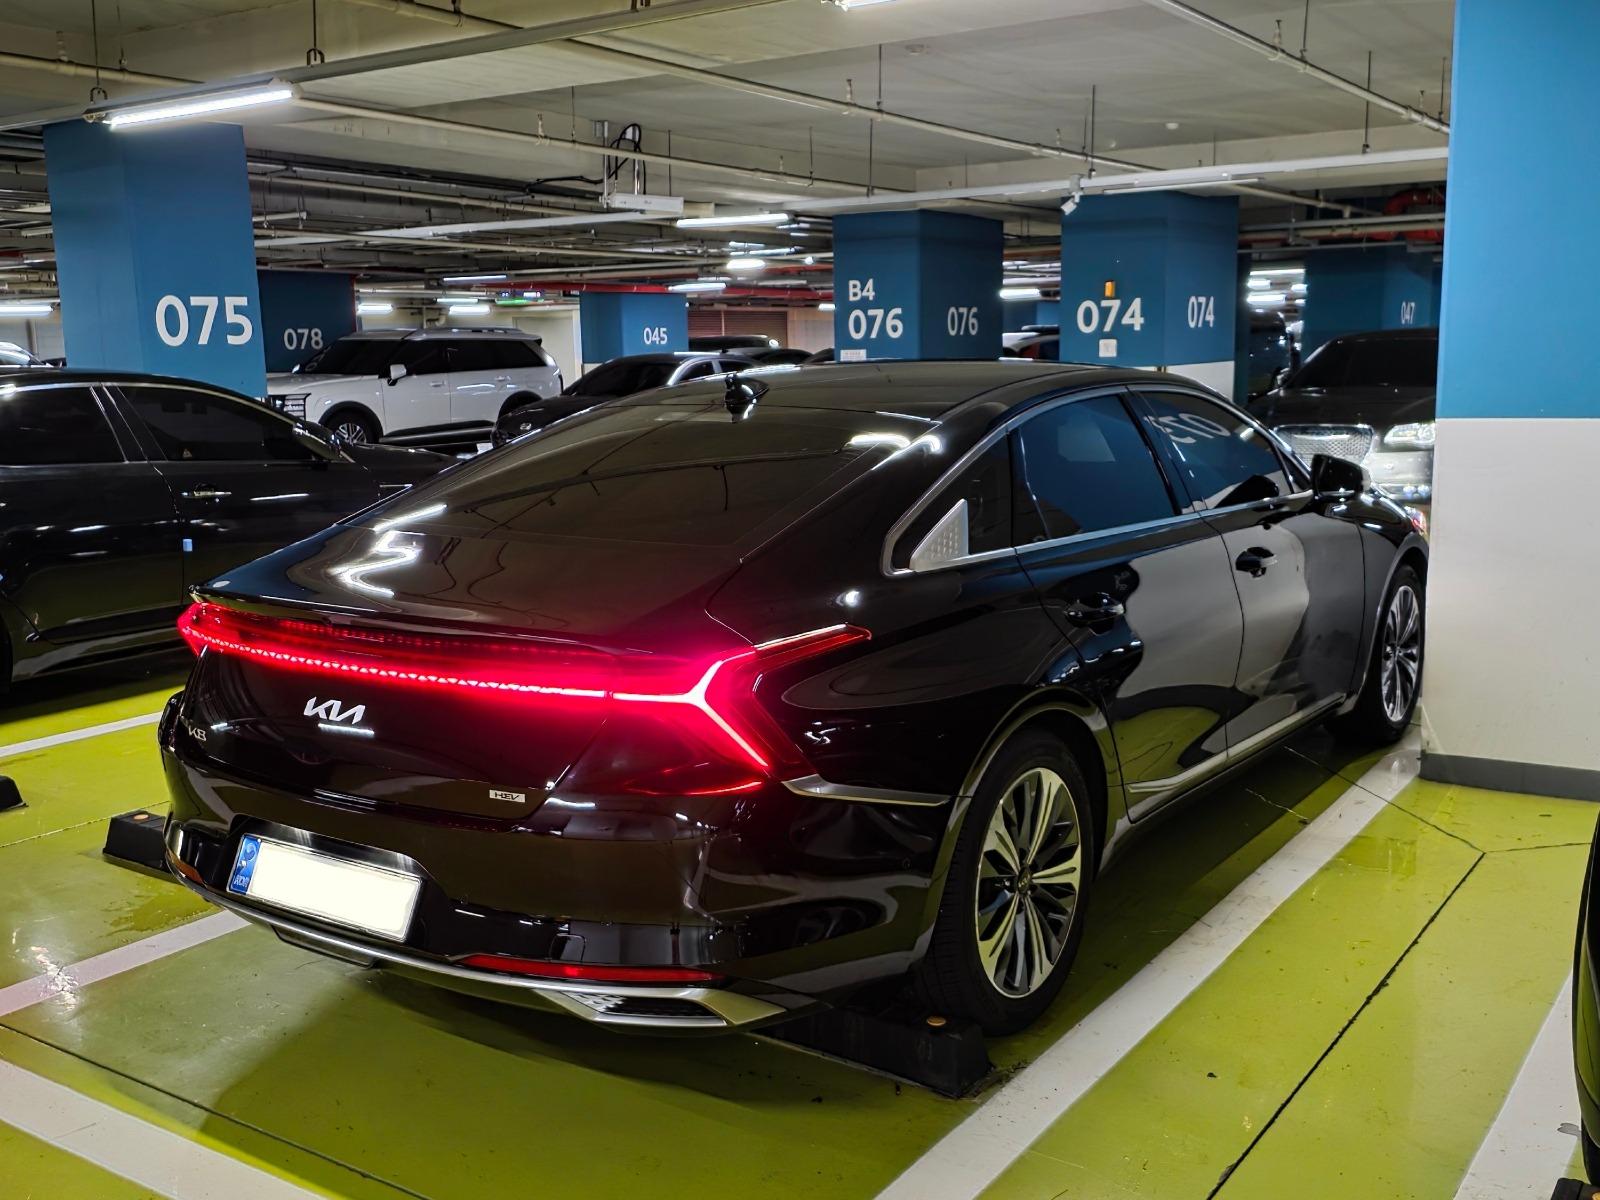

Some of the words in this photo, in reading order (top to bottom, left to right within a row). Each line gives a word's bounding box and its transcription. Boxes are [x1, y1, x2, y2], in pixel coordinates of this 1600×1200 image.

[848, 278, 875, 302] B4
[155, 294, 253, 347] 075
[848, 307, 904, 340] 076
[947, 306, 978, 336] 076
[1076, 297, 1144, 334] 074
[1187, 296, 1215, 328] 074
[1401, 300, 1416, 325] 047
[283, 327, 323, 351] 078
[643, 327, 668, 345] 045
[303, 696, 366, 725] KIA
[188, 727, 207, 742] K8
[494, 791, 520, 801] HEV
